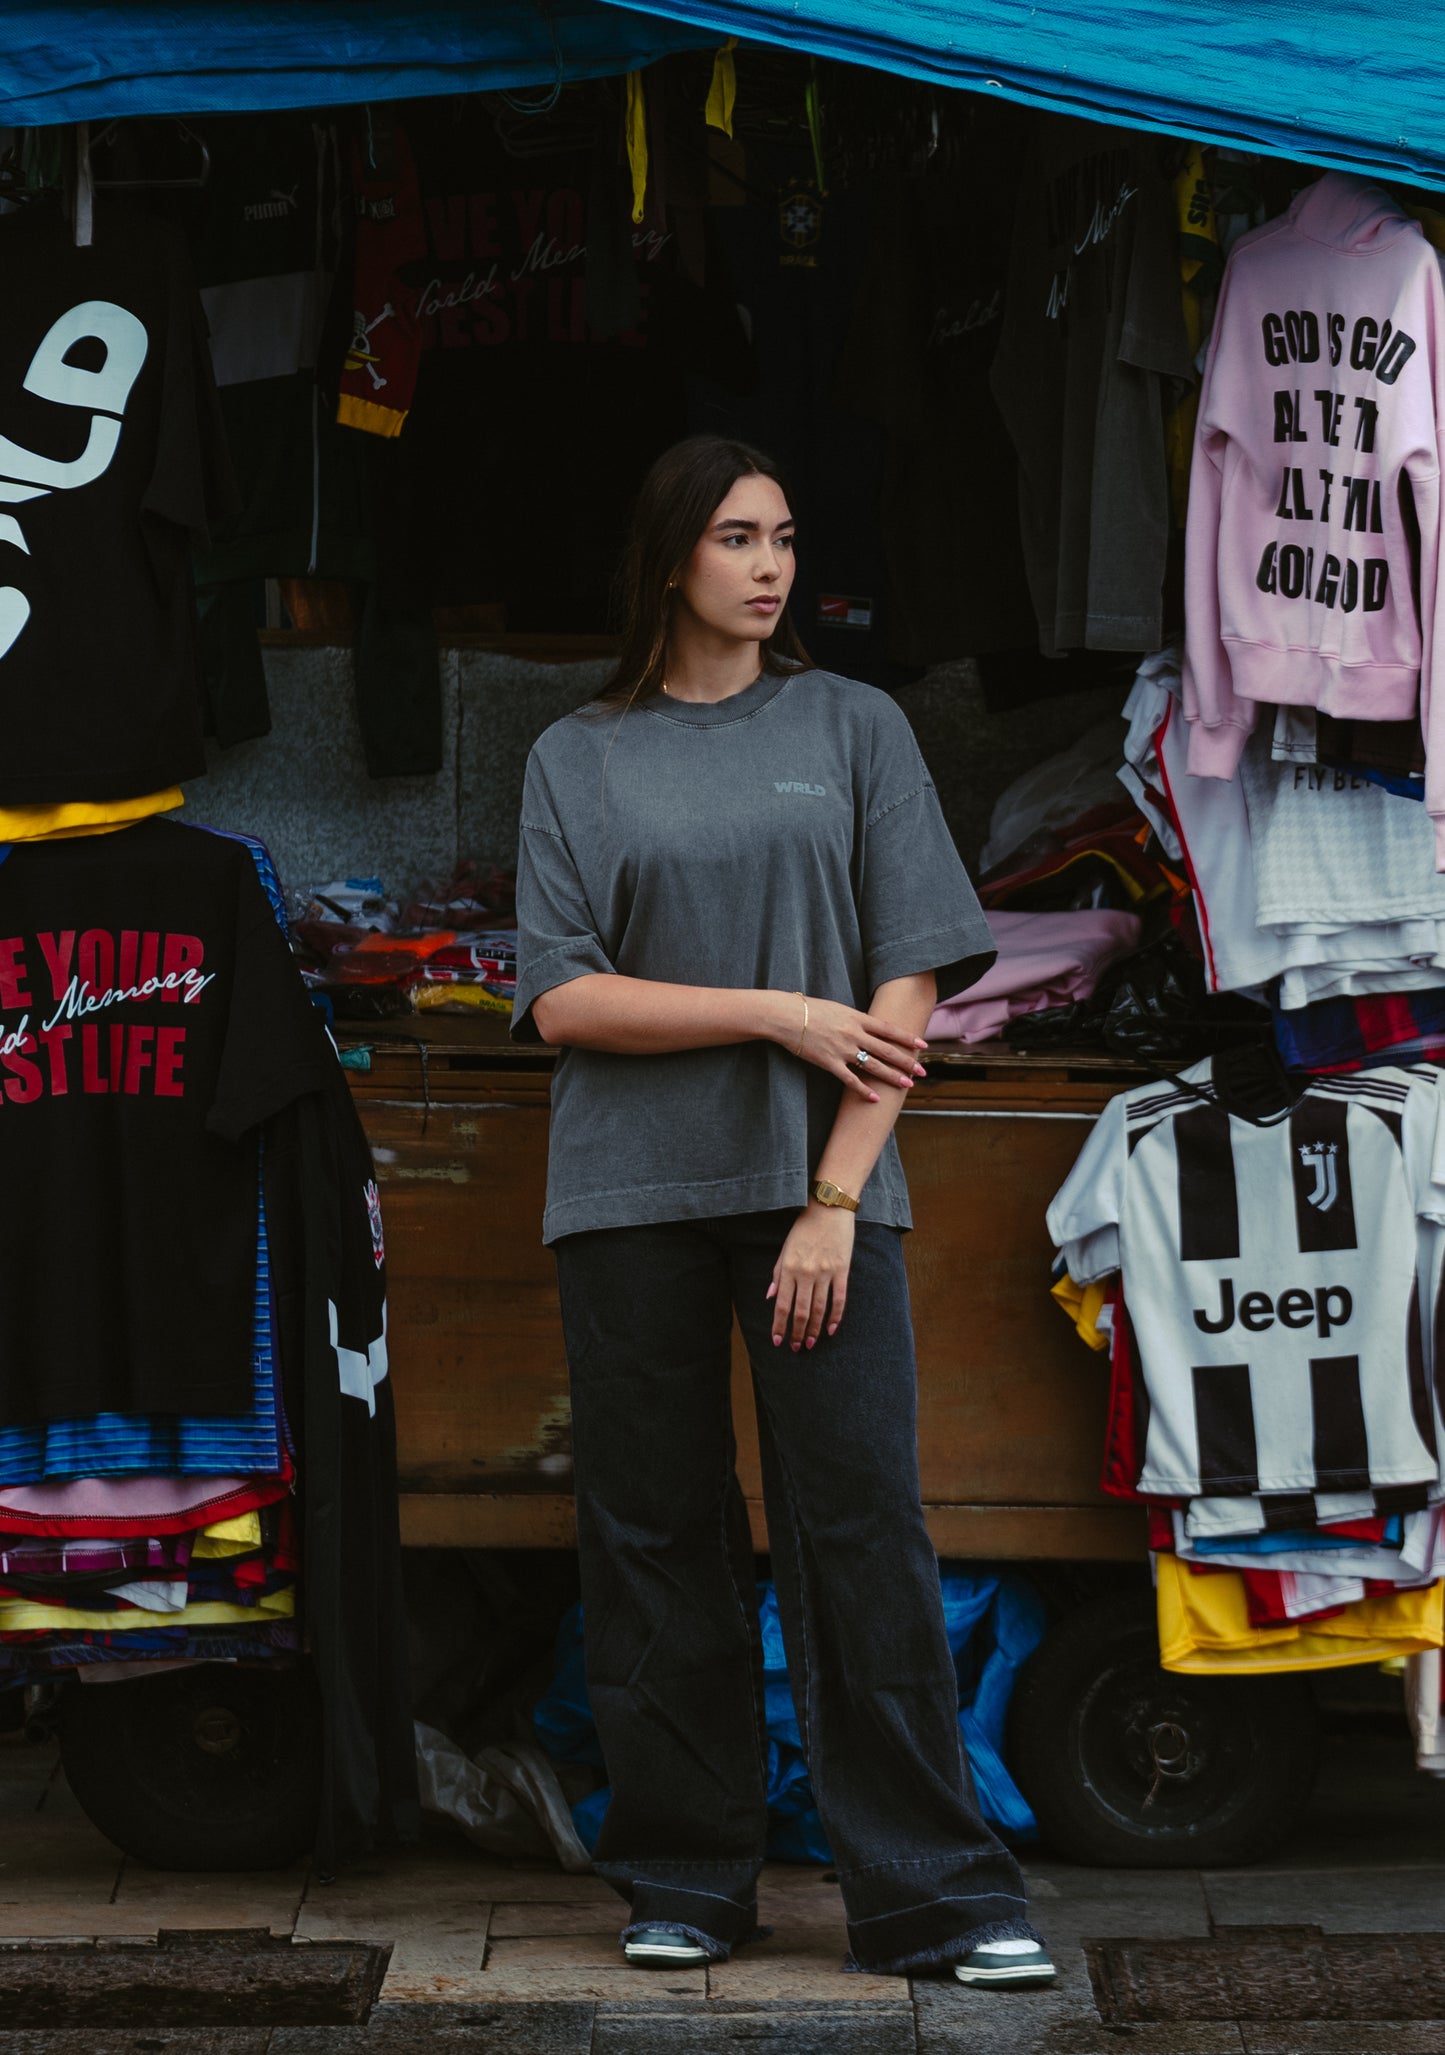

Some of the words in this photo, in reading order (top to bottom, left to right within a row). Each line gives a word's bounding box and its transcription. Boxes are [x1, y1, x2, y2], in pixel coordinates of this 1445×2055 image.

[773, 781, 826, 797] WRLD
[36, 928, 204, 1004] YOUR
[42, 968, 216, 1032] Memory
[82, 1023, 187, 1097] LIFE
[1193, 1278, 1353, 1339] Jeep
